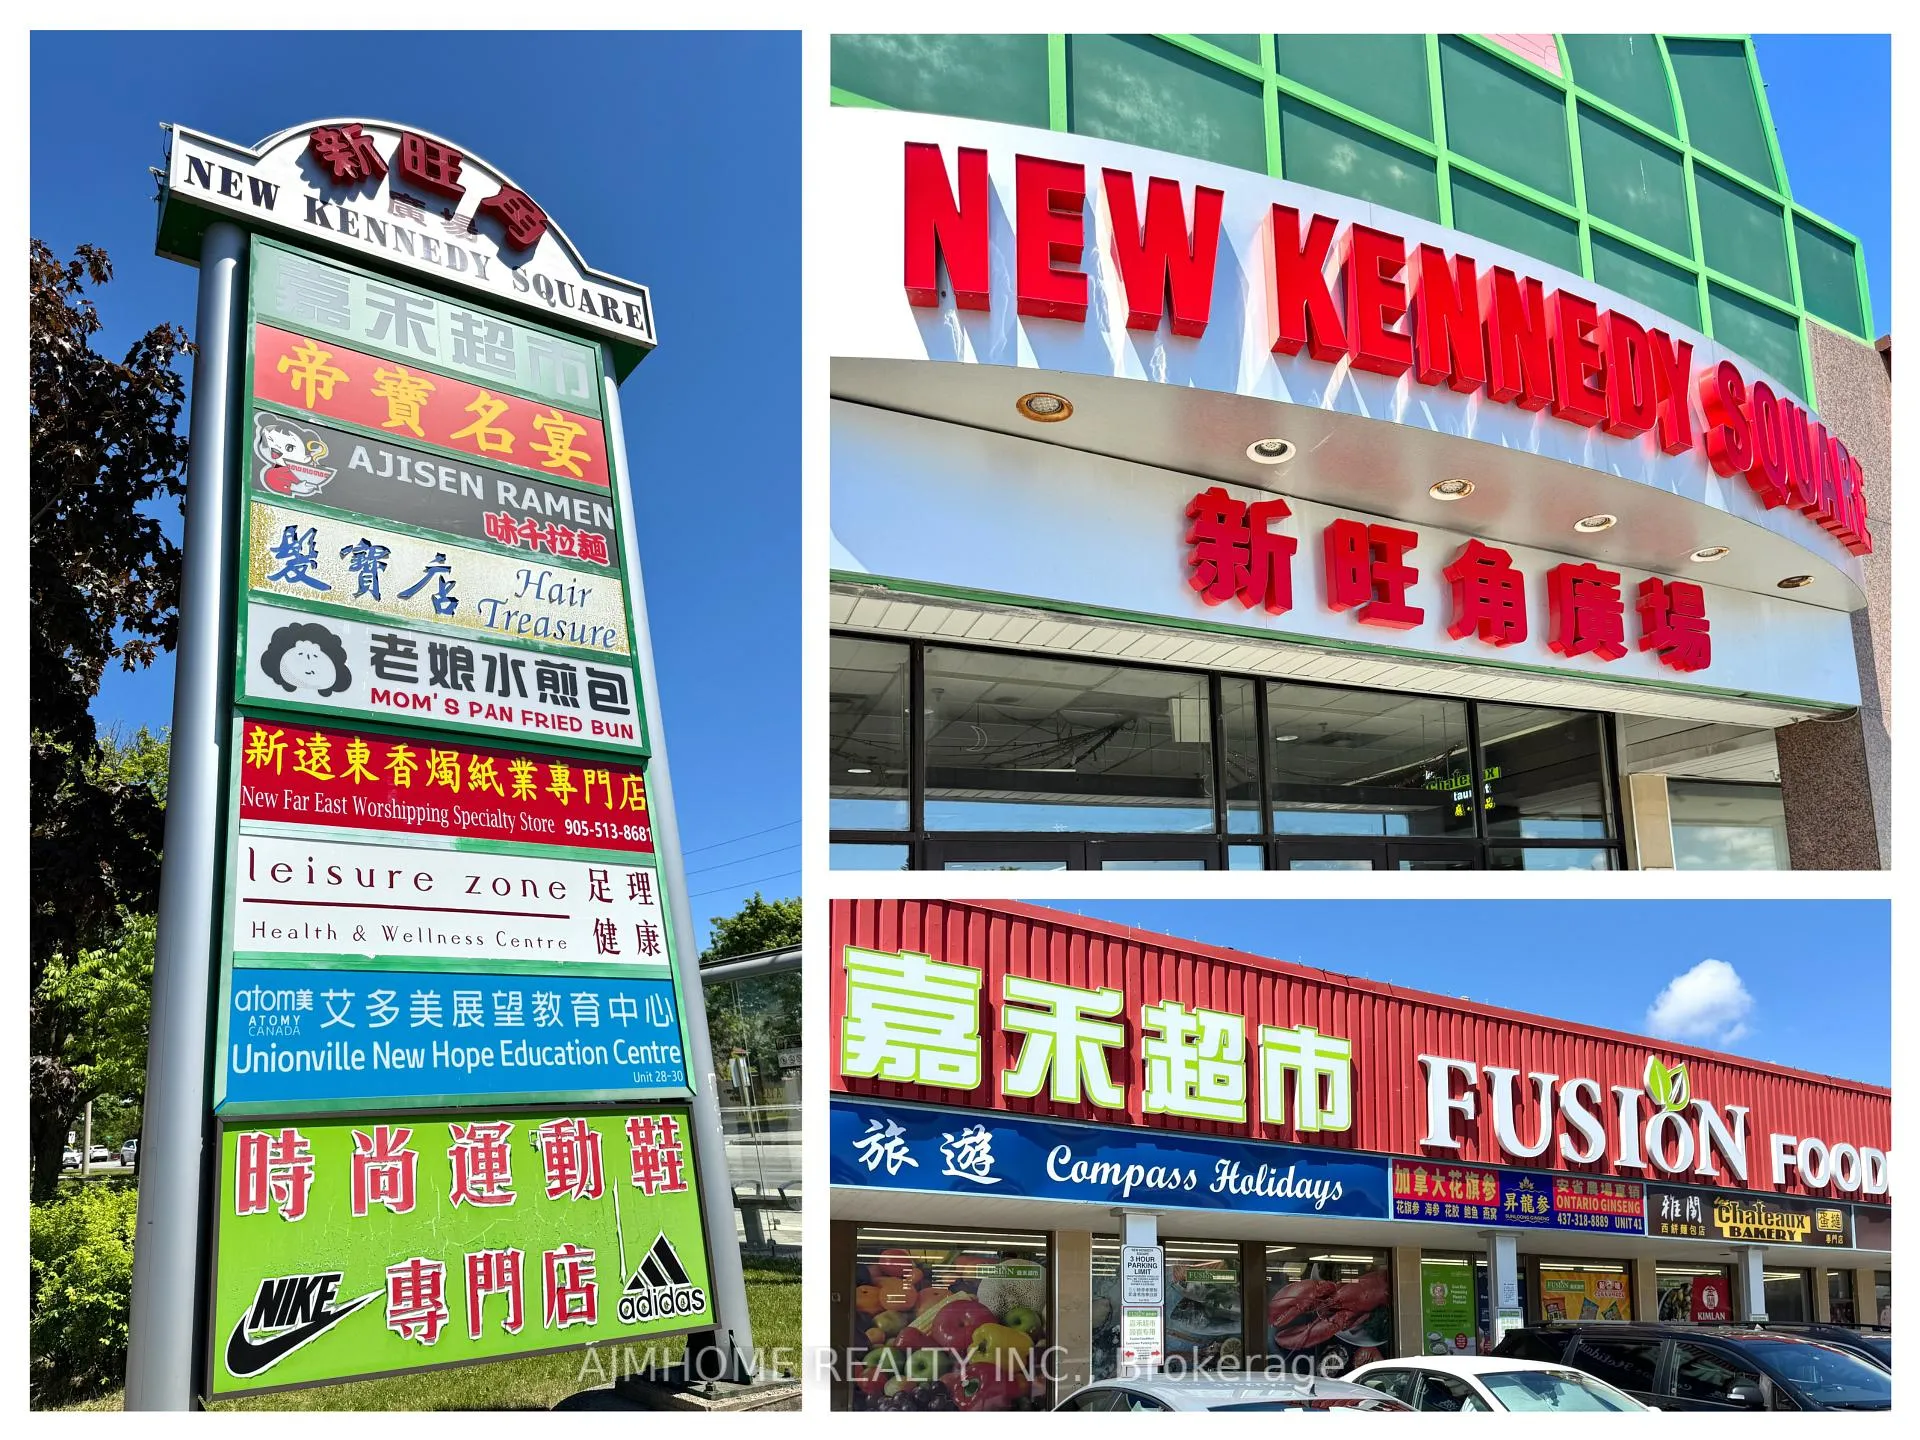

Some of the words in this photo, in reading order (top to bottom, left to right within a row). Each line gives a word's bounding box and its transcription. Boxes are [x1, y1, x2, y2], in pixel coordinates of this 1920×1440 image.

[309, 122, 548, 252] 新旺角
[184, 154, 281, 211] NEW
[304, 194, 492, 282] KENNEDY
[513, 265, 645, 332] SQUARE
[276, 258, 590, 400] 嘉禾超市
[904, 141, 1224, 338] NEW
[1263, 202, 1694, 455] KENNEDY
[1699, 360, 1873, 557] SQUARE
[277, 338, 592, 478] 帝寶名宴
[347, 445, 484, 500] AJISEN
[496, 480, 615, 530] RAMEN
[267, 524, 459, 617] 髮寶店
[516, 568, 593, 609] Hair
[1185, 487, 1713, 673] 新旺角廣場
[477, 598, 617, 649] Treasure
[370, 632, 631, 716] 老娘水煎包
[371, 687, 460, 714] MOM'S
[469, 702, 514, 723] PAN
[521, 711, 583, 733] FRIED
[592, 719, 634, 740] BUN
[245, 725, 647, 812] 新遠東香燭紙業專門店
[241, 785, 278, 808] New
[284, 789, 310, 811] Far
[315, 792, 348, 815] East
[353, 795, 449, 827] Worshipping
[453, 806, 517, 834] Specialty
[520, 812, 555, 834] Store
[564, 819, 653, 842] 905-513-8681
[248, 847, 434, 892] leisure
[465, 872, 568, 900] zone
[251, 920, 338, 942] Health
[353, 924, 367, 942] &
[381, 923, 484, 947] Wellness
[496, 930, 568, 950] Centre
[248, 1015, 301, 1026] ATOMY
[248, 1026, 301, 1036] CANADA
[320, 987, 675, 1029] 艾多美展望教育中心
[232, 1042, 365, 1074] Unionville
[373, 1042, 424, 1070] New
[432, 1040, 494, 1074] Hope
[501, 1038, 608, 1067] Education
[613, 1038, 681, 1065] Centre
[842, 944, 1351, 1133] 嘉禾超市
[633, 1071, 653, 1083] Unit
[655, 1070, 684, 1082] 28-30
[1417, 1053, 1750, 1181] FUSION
[1771, 1132, 1890, 1196] FOOD
[235, 1114, 689, 1222] 時尚運動鞋
[1046, 1144, 1197, 1203] Compass
[1209, 1158, 1344, 1210] Holidays
[1556, 1195, 1599, 1211] ONTARIO
[1601, 1198, 1641, 1214] GINSENG
[1557, 1212, 1609, 1228] 437-318-8889
[1614, 1216, 1632, 1229] UNIT
[1633, 1218, 1643, 1230] 41
[1718, 1200, 1806, 1229] Chateaux
[1729, 1226, 1797, 1241] BAKERY
[248, 1272, 344, 1330] NIKE
[386, 1243, 599, 1346] 專門店
[617, 1286, 706, 1321] adidas
[1697, 1311, 1726, 1320] KIMLAN
